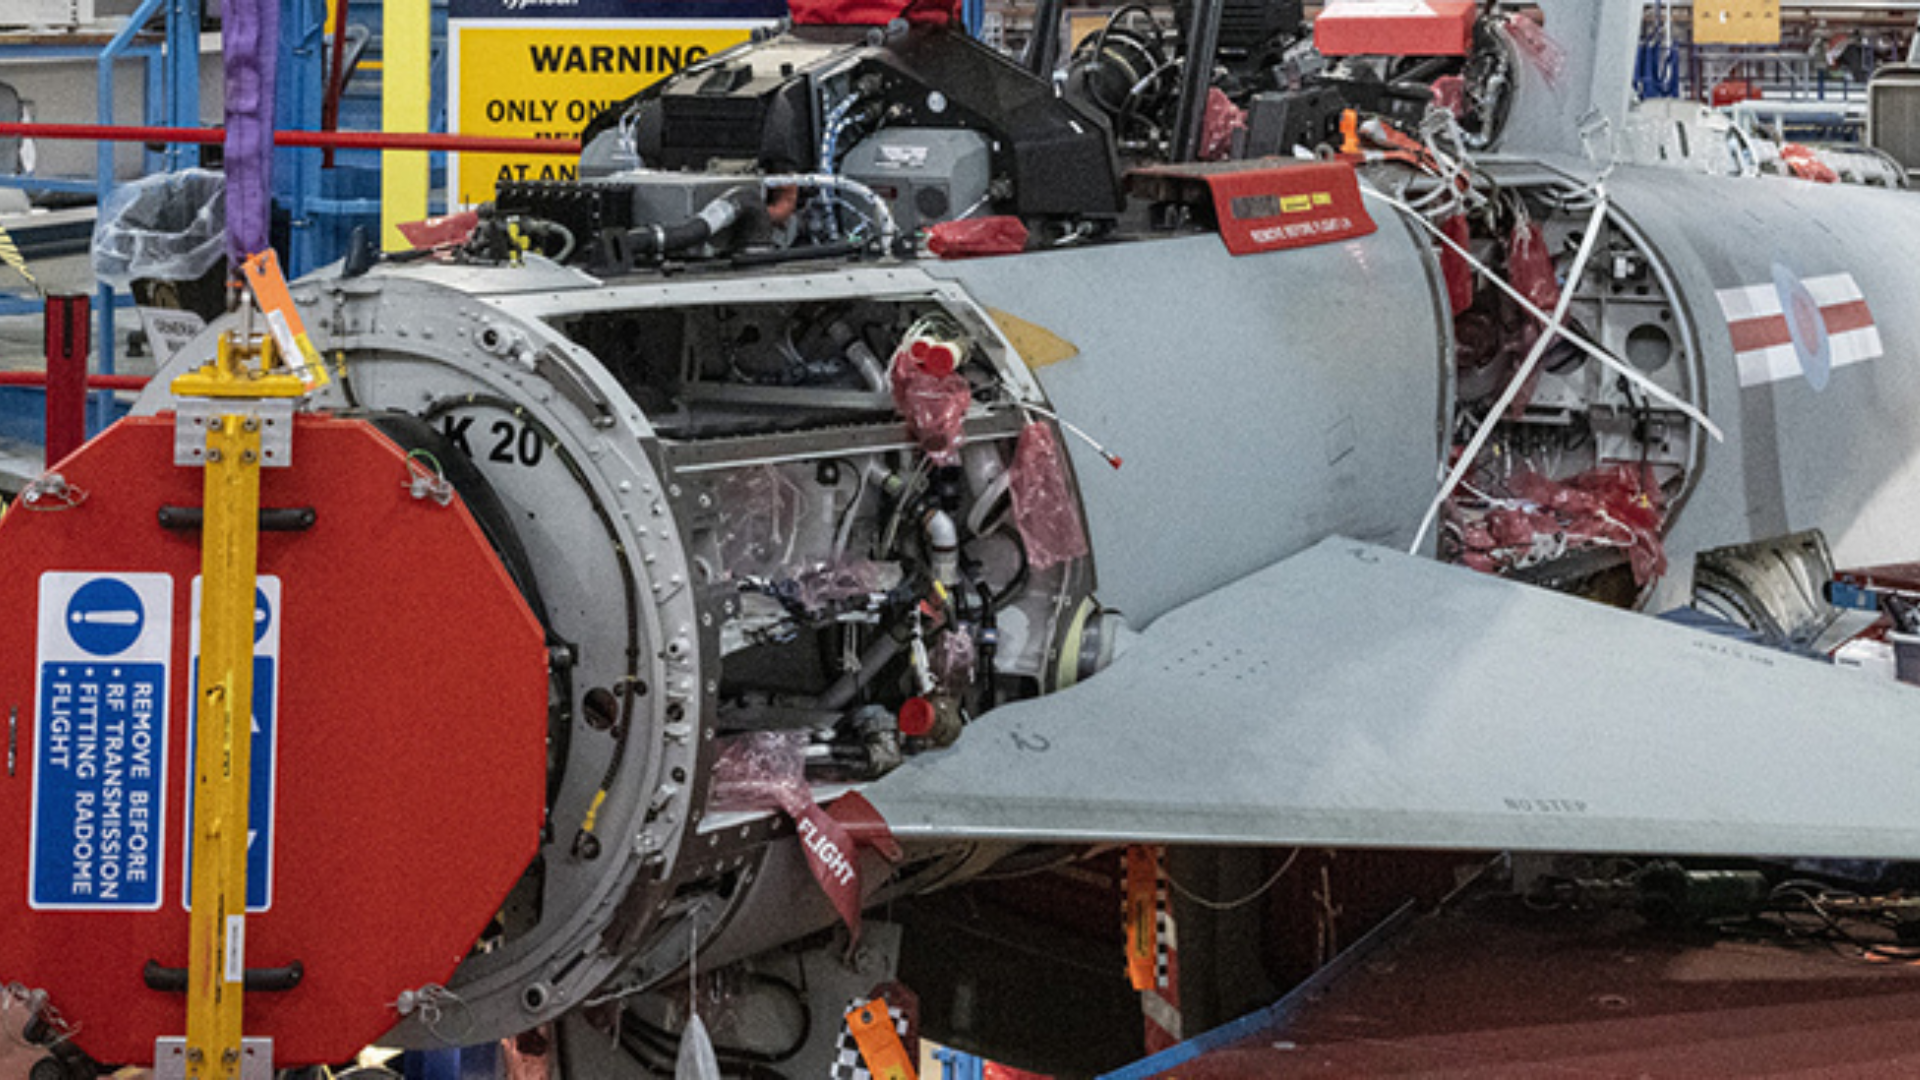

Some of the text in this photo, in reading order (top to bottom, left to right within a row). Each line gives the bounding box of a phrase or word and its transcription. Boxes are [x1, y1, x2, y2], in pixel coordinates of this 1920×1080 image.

[486, 100, 623, 122] ONLY ON
[498, 165, 578, 181] AT AN
[489, 421, 542, 466] 20
[50, 683, 71, 769] FLIGHT
[73, 683, 99, 894] FITTING RADOME
[99, 683, 126, 898] RF TRANSMISSION
[127, 683, 153, 881] REMOVE BEFORE
[798, 817, 854, 886] FLIGHT
